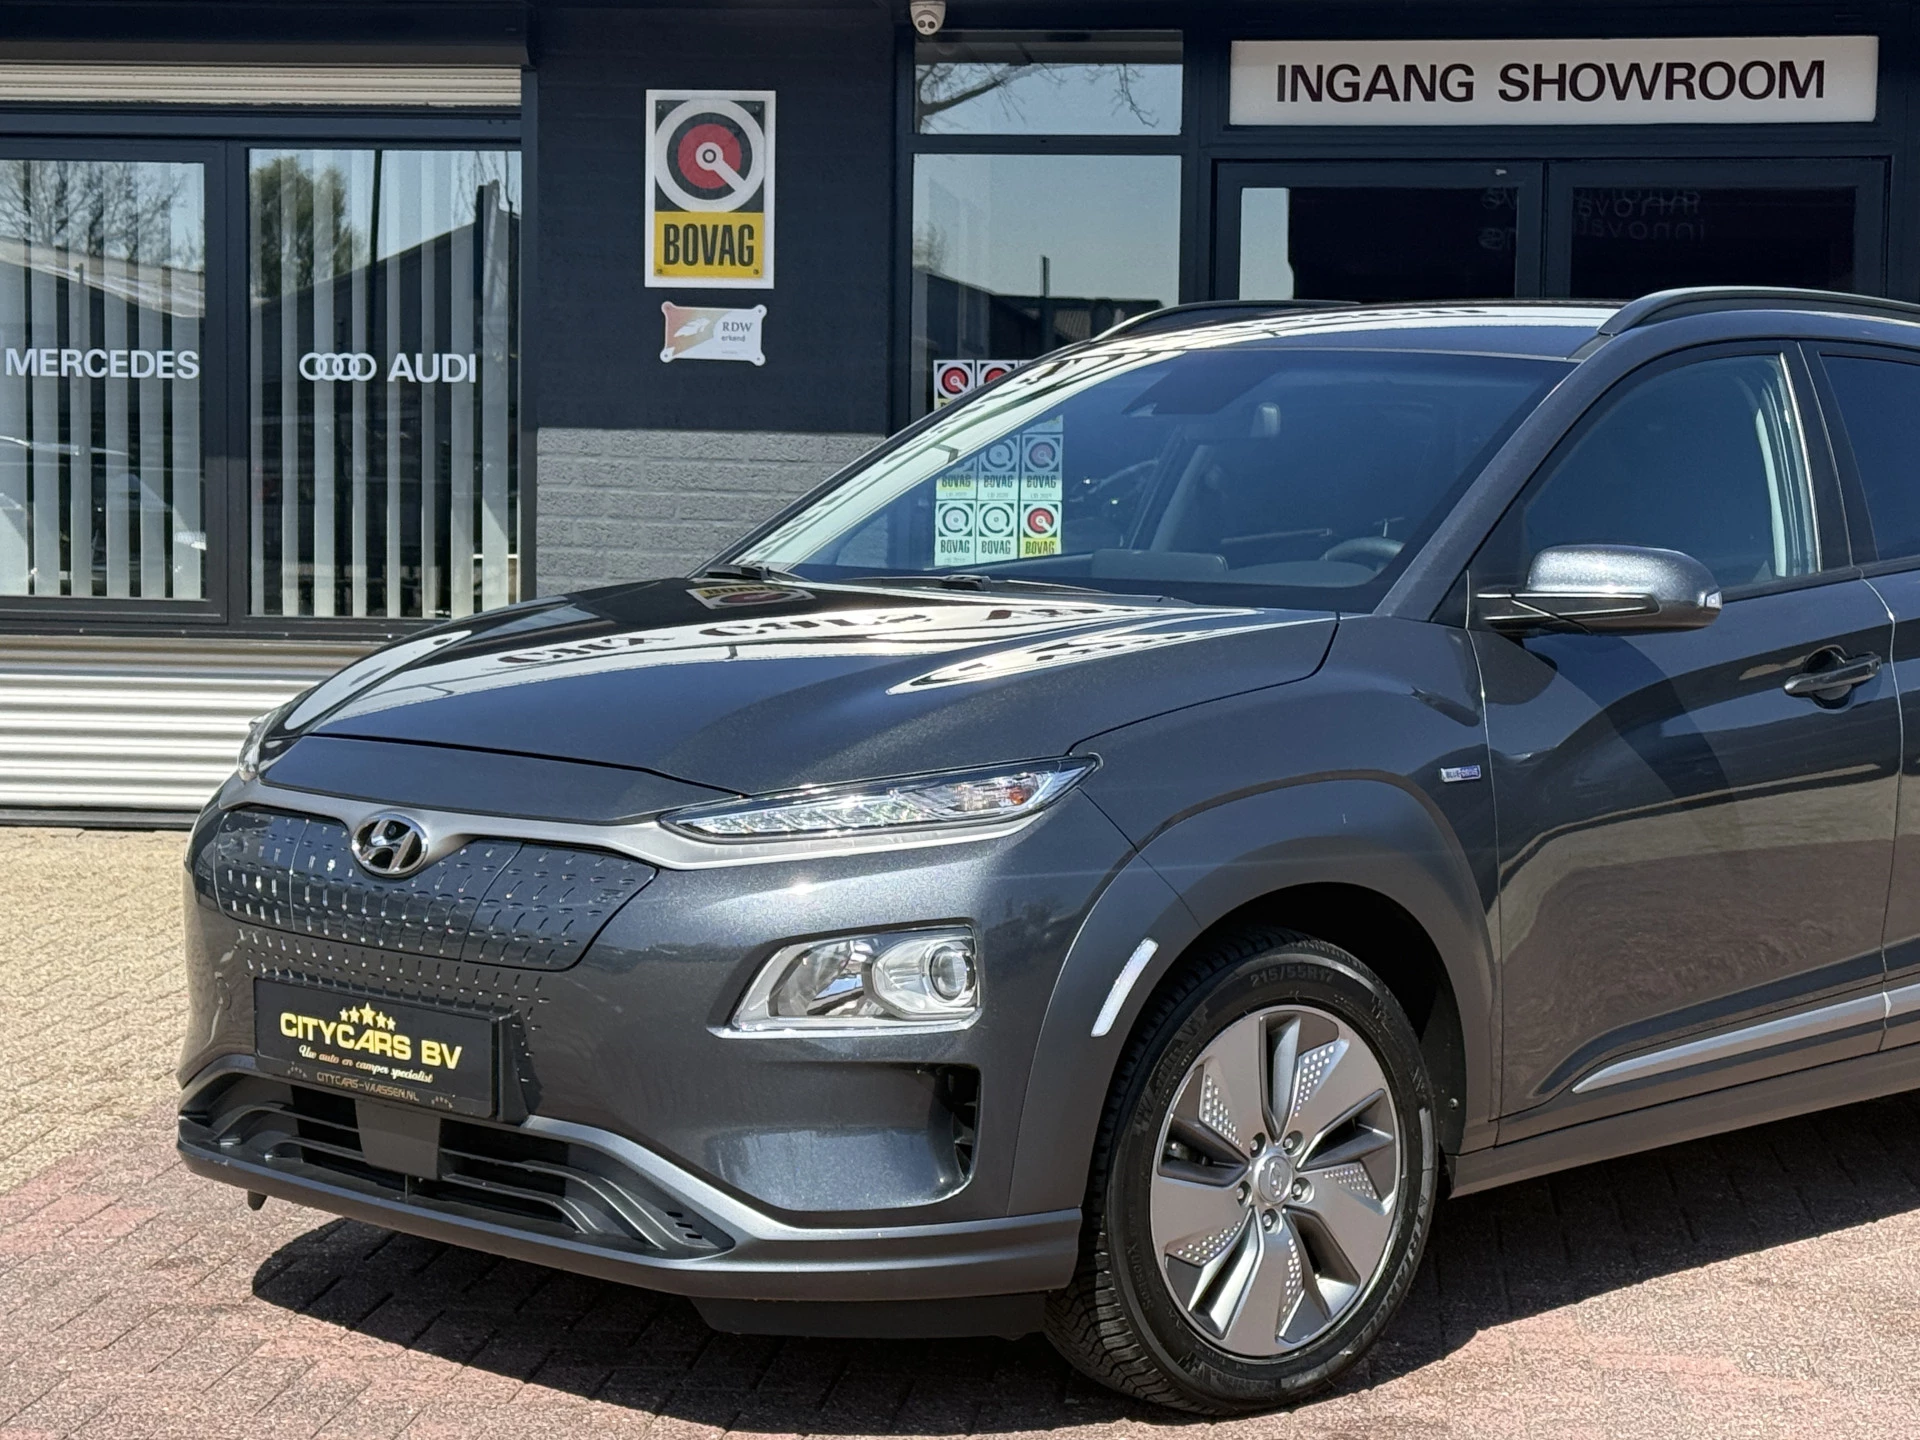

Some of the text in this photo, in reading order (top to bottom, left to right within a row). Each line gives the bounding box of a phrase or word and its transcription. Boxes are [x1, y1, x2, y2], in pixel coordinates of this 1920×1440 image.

[1276, 59, 1826, 103] INGANG SHOWROOM
[663, 223, 755, 267] BOVAG
[721, 321, 753, 332] RDW
[5, 347, 200, 379] MERCEDES
[387, 352, 477, 383] AUDI
[983, 475, 1013, 489] BOVAG
[1026, 475, 1056, 489] BOVAG
[940, 539, 970, 554] BOVAG
[981, 540, 1011, 555] BOVAG
[1025, 541, 1055, 555] BOVAG
[279, 1012, 463, 1070] CITYCARS BV
[318, 1053, 340, 1064] auto
[341, 1057, 354, 1067] en
[355, 1061, 390, 1075] camper
[390, 1067, 434, 1084] specialist
